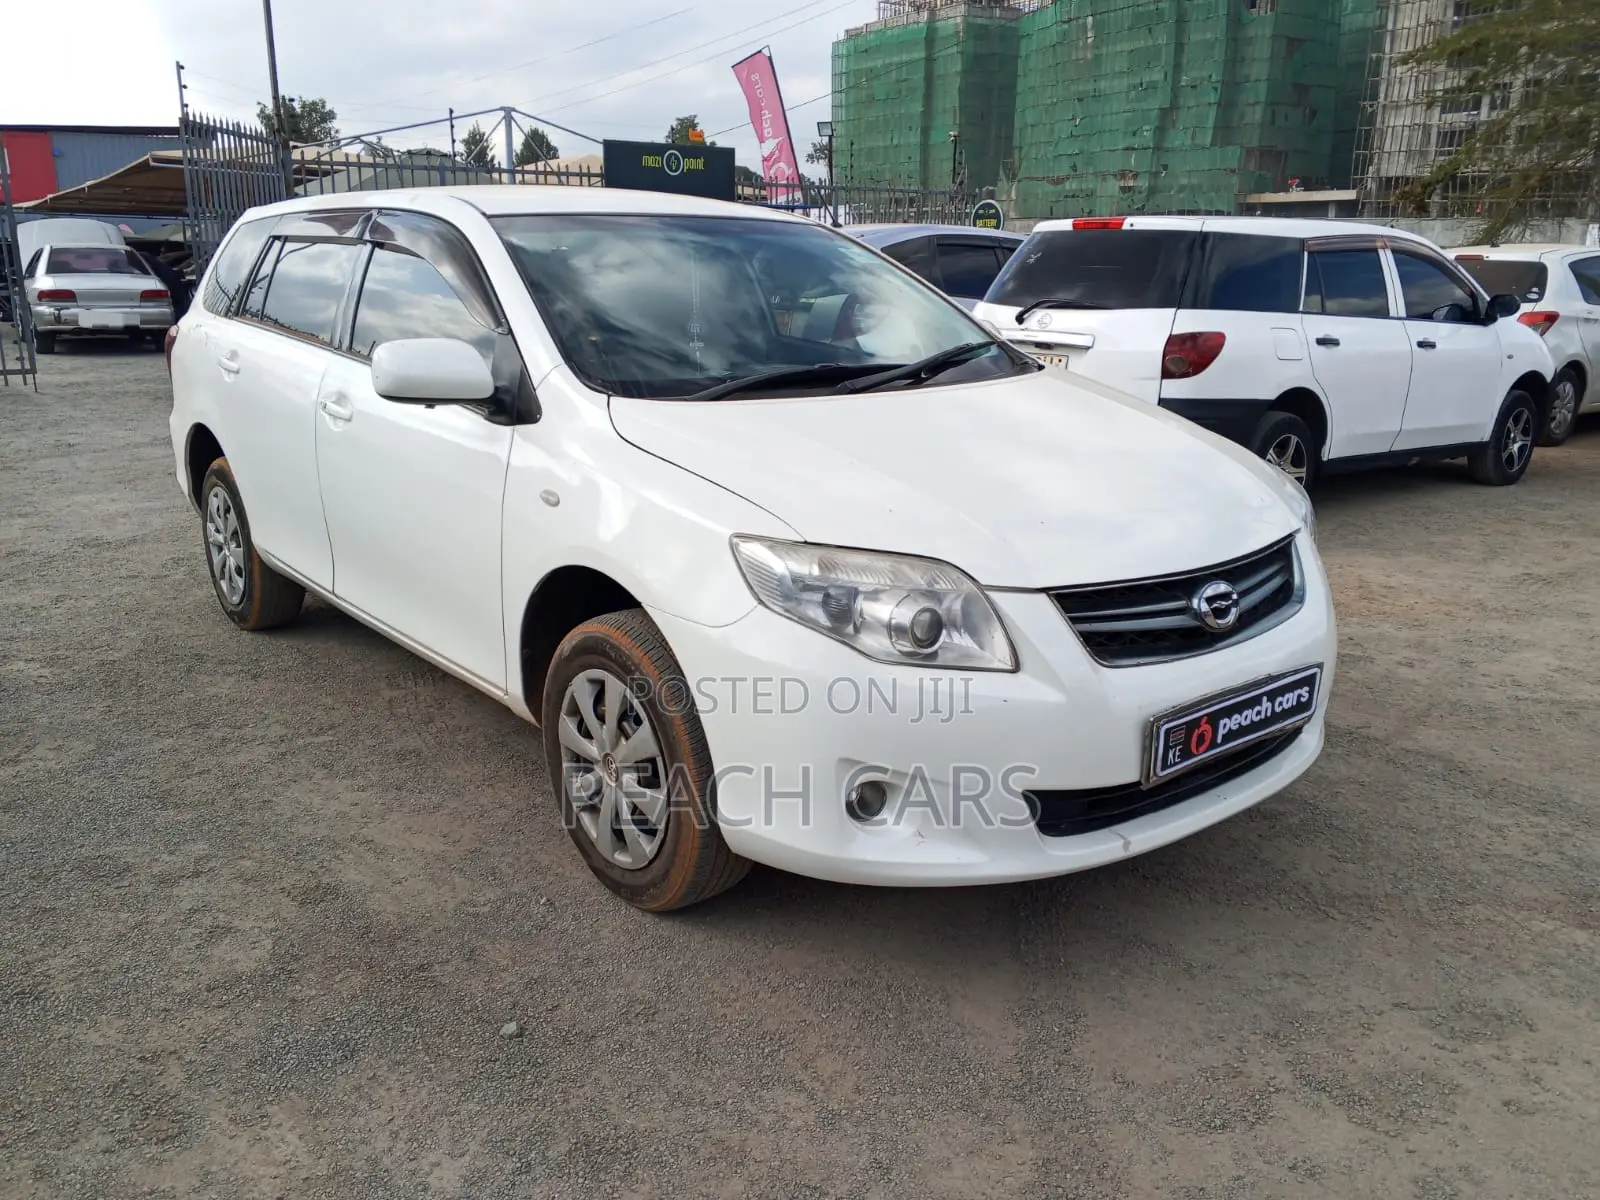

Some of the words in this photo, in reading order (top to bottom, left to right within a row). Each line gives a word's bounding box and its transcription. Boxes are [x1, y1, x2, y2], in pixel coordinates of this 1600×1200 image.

[1217, 696, 1272, 744] peach
[1274, 685, 1310, 713] cars
[1167, 745, 1183, 766] KE
